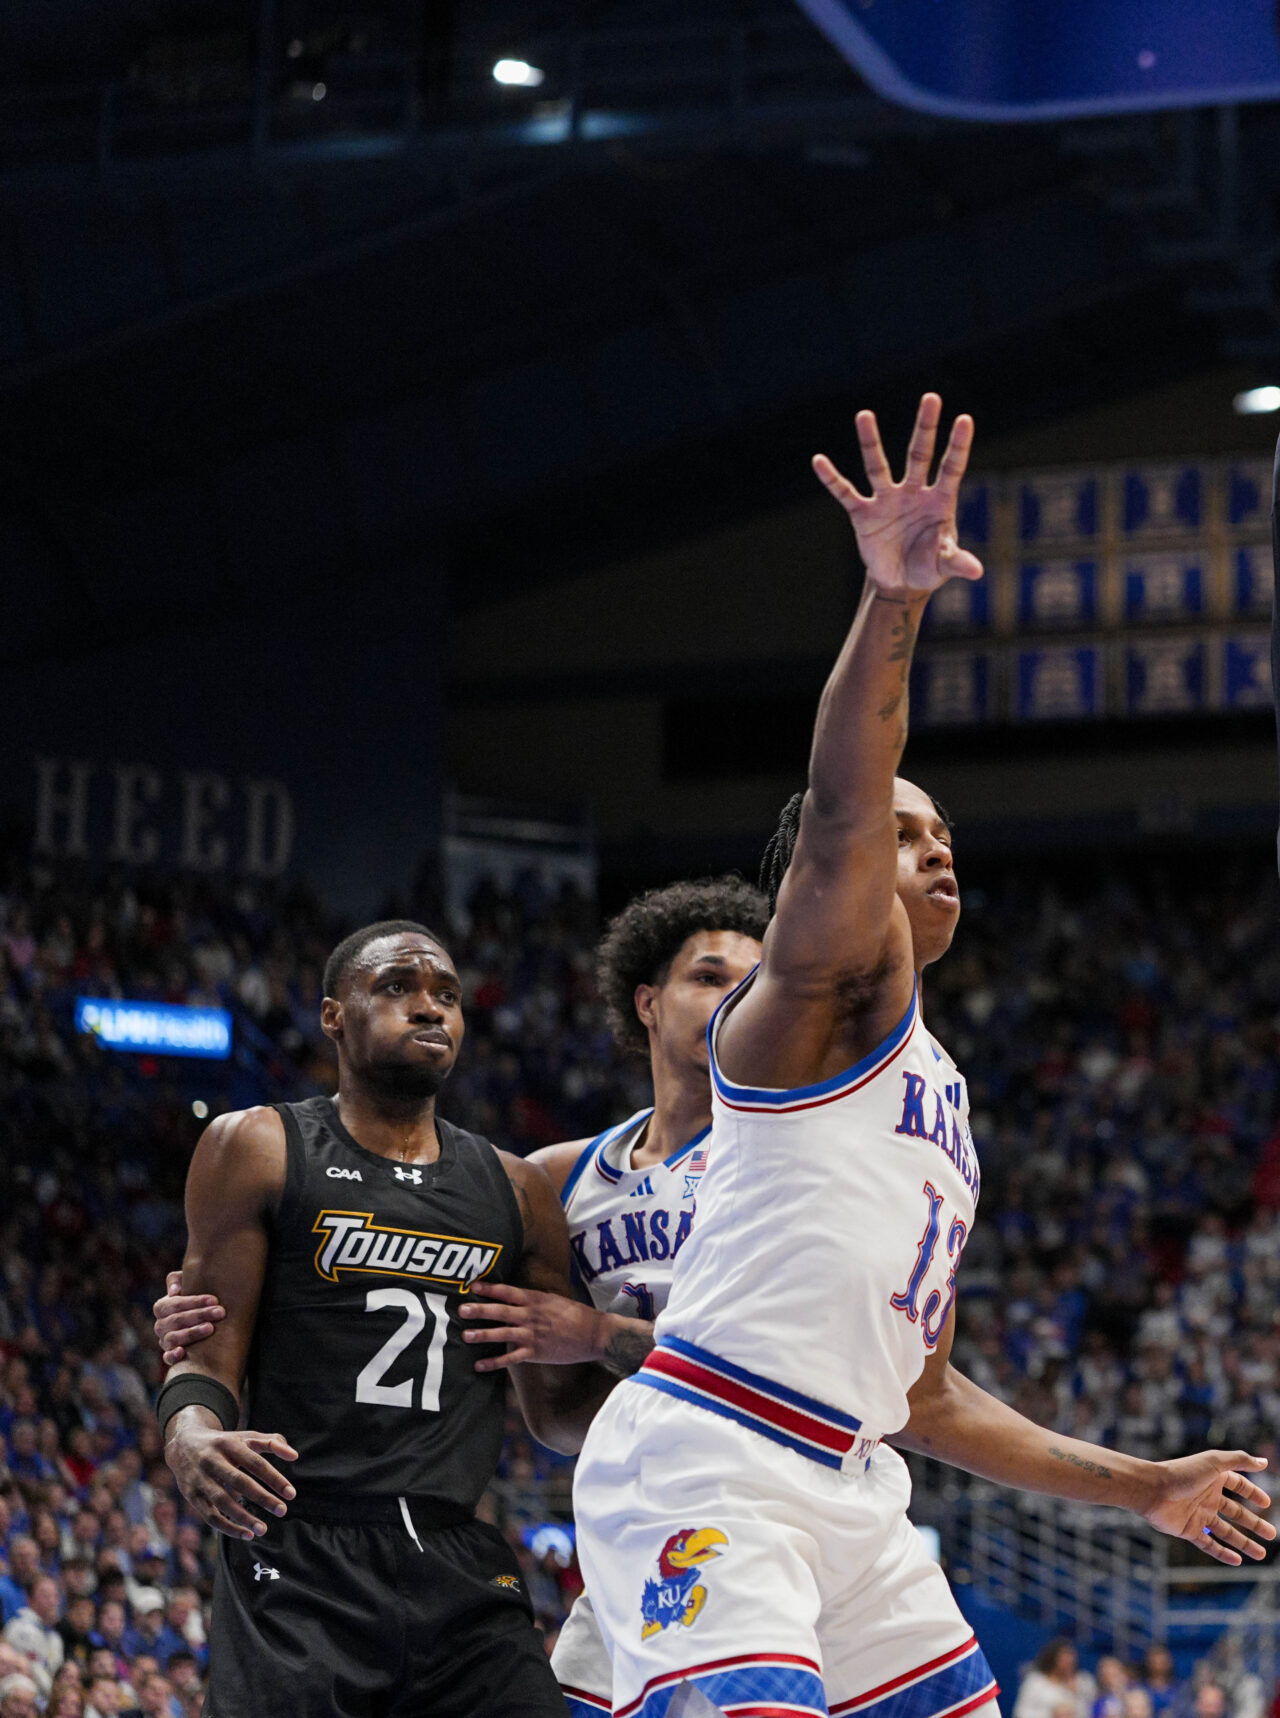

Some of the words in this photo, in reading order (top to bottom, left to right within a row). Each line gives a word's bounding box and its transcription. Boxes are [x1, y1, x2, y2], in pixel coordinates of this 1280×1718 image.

[34, 755, 296, 877] HEED
[325, 1166, 363, 1182] CAA
[316, 1213, 499, 1290] TOWSON
[569, 1199, 698, 1284] KANSA
[889, 1179, 967, 1350] 13
[355, 1287, 451, 1412] 21
[657, 1584, 681, 1609] KU
